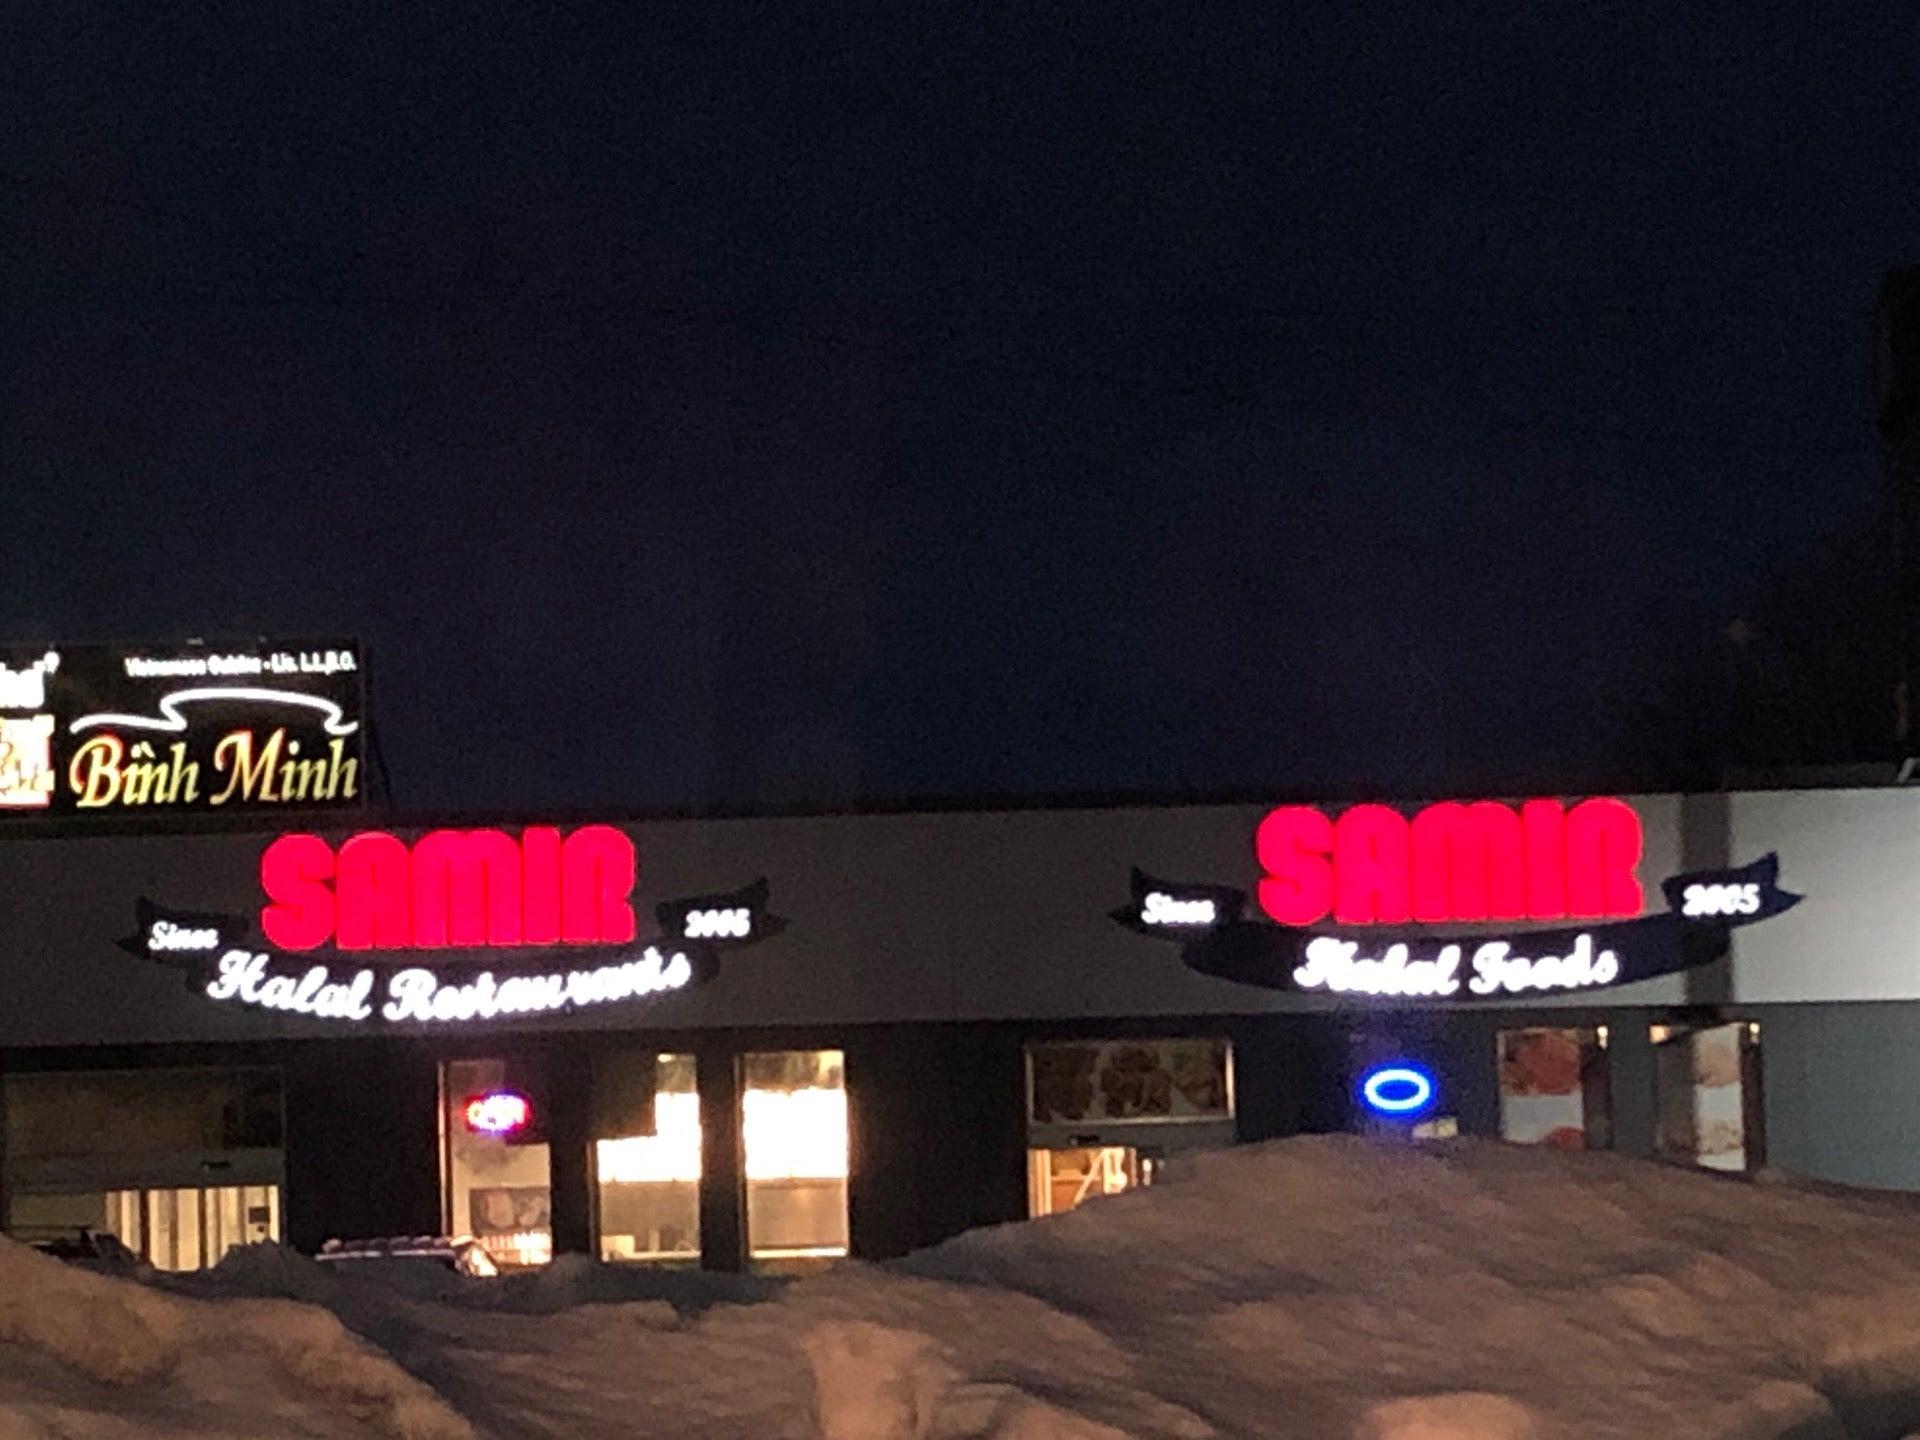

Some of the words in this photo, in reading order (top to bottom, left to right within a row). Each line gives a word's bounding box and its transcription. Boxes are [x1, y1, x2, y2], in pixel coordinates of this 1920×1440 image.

[209, 727, 359, 806] Minh
[260, 824, 637, 952] SAMIR
[1256, 797, 1646, 927] SAMIR
[206, 951, 374, 1021] Halal
